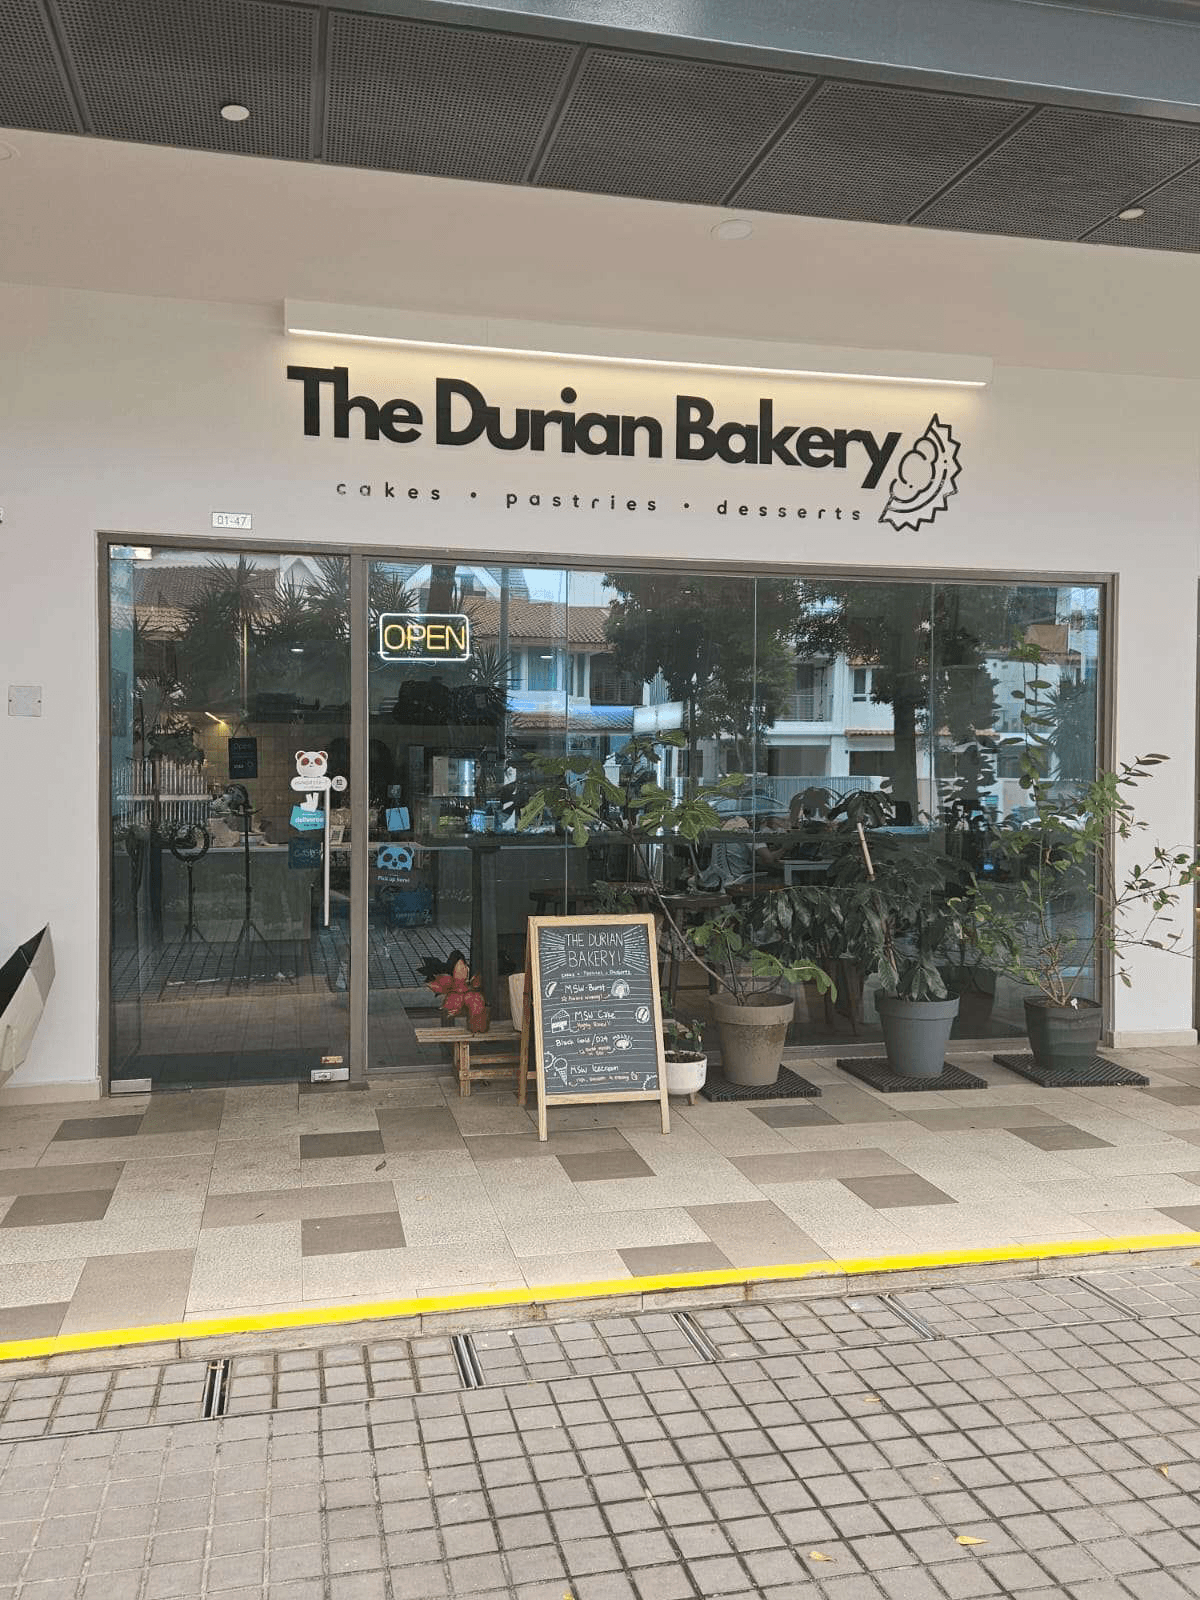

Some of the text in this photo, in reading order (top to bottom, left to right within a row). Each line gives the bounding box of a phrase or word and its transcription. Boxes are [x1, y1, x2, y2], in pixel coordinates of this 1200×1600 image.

[287, 365, 902, 489] The Durian Bakery
[336, 481, 860, 521] cakes pastries desserts
[217, 515, 247, 526] 01-47
[384, 624, 465, 650] OPEN
[565, 931, 624, 947] THE DURIAN
[568, 949, 622, 968] BAKERY!
[574, 1010, 594, 1021] MSW
[570, 1065, 588, 1074] MSW
